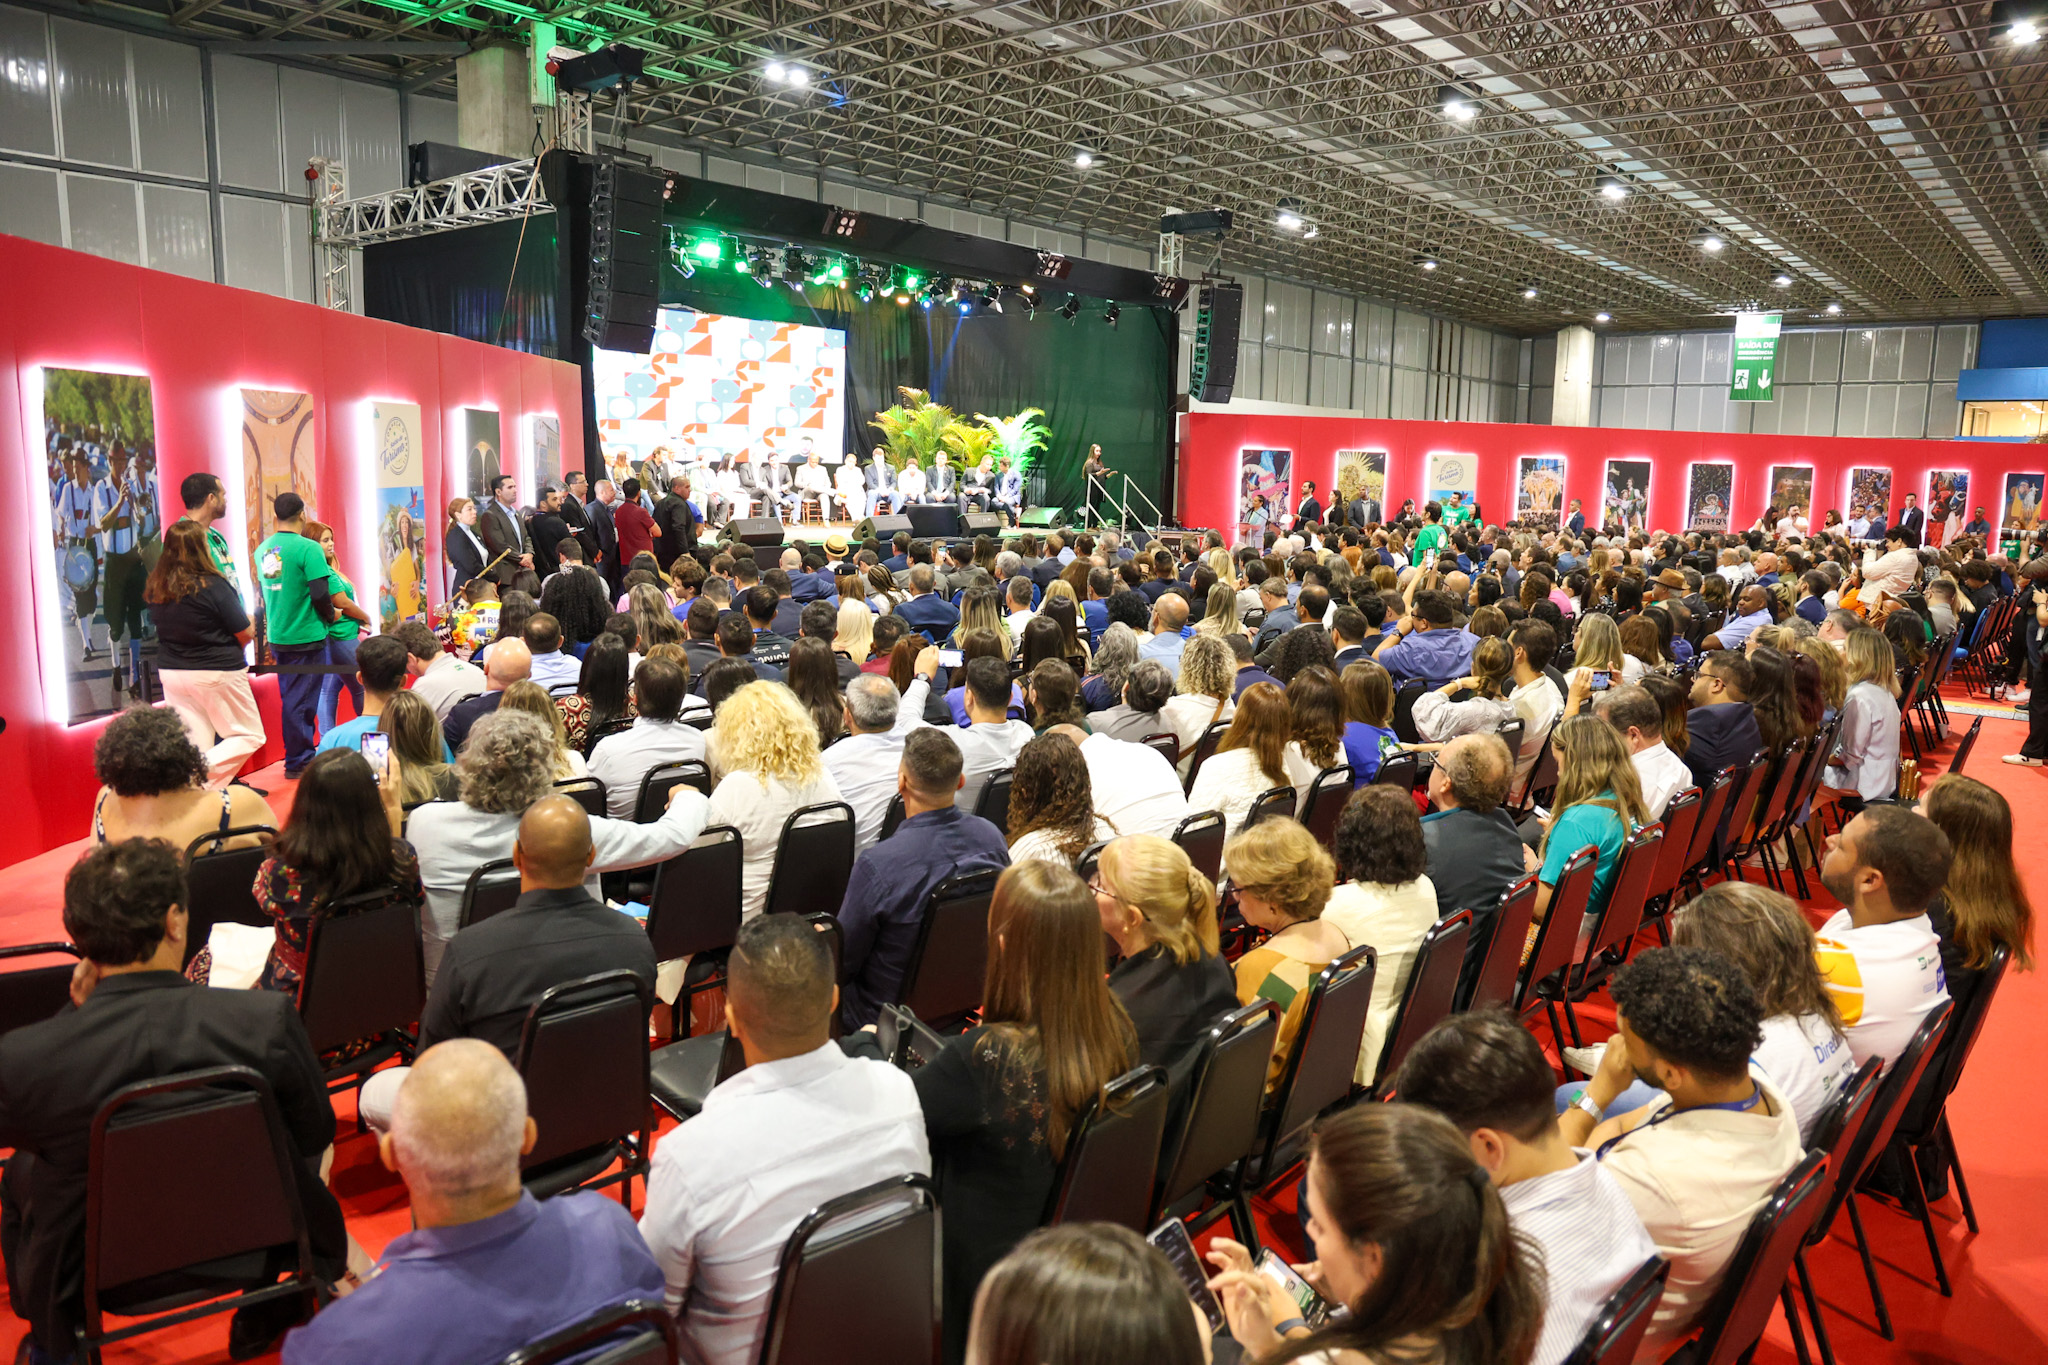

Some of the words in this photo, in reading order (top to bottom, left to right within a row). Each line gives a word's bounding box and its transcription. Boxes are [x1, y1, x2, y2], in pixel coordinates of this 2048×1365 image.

[1738, 340, 1762, 349] SAÍDA
[1763, 341, 1775, 349] DE
[380, 443, 405, 470] Turismo
